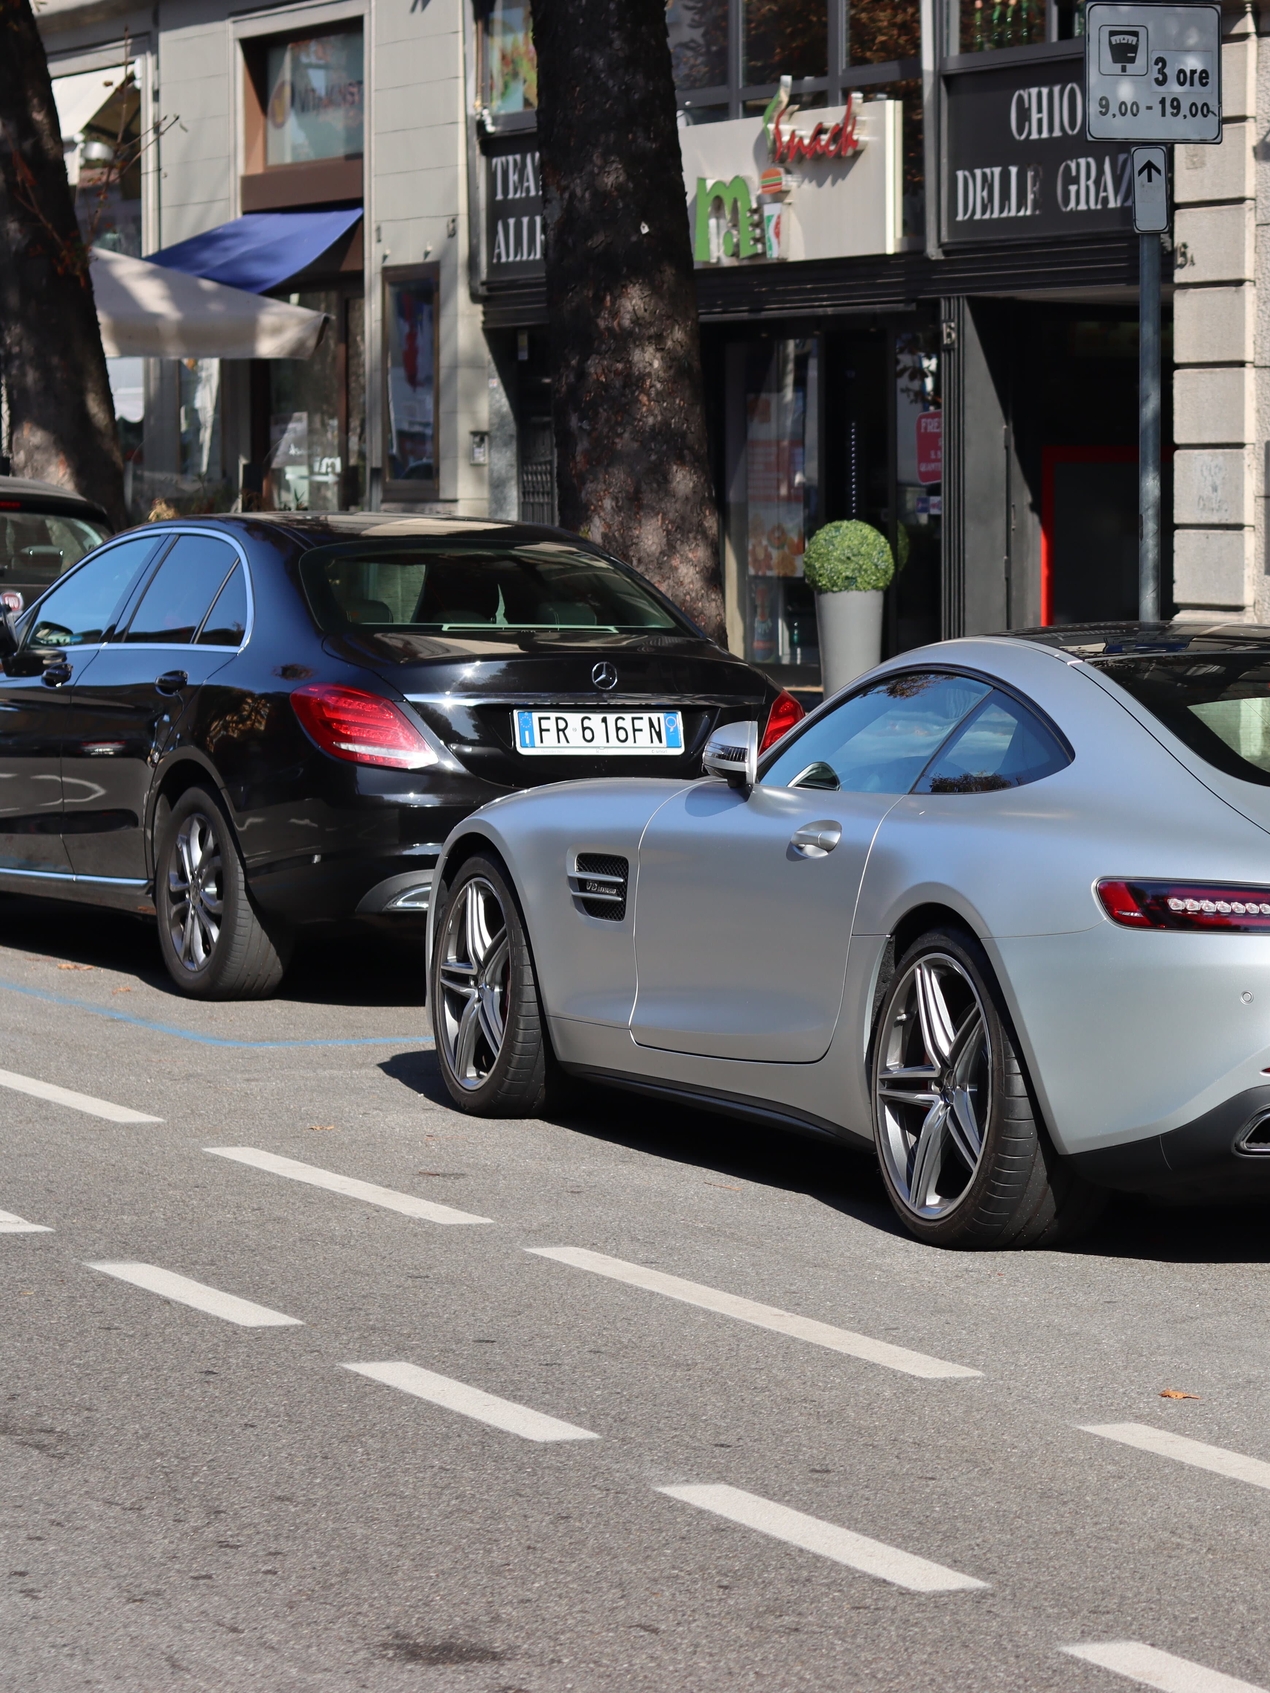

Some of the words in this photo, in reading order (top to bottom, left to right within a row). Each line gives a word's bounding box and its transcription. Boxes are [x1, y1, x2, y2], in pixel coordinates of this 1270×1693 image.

[1154, 56, 1168, 86] 3
[1176, 68, 1210, 87] ore
[1010, 82, 1083, 141] CHIO
[1099, 96, 1139, 119] 9,00
[1159, 97, 1210, 119] 19,00
[492, 151, 542, 201] TEA
[955, 164, 1043, 221] DELLE
[1056, 153, 1133, 212] GRAZ
[538, 716, 570, 745] FR
[580, 715, 663, 745] 616FN
